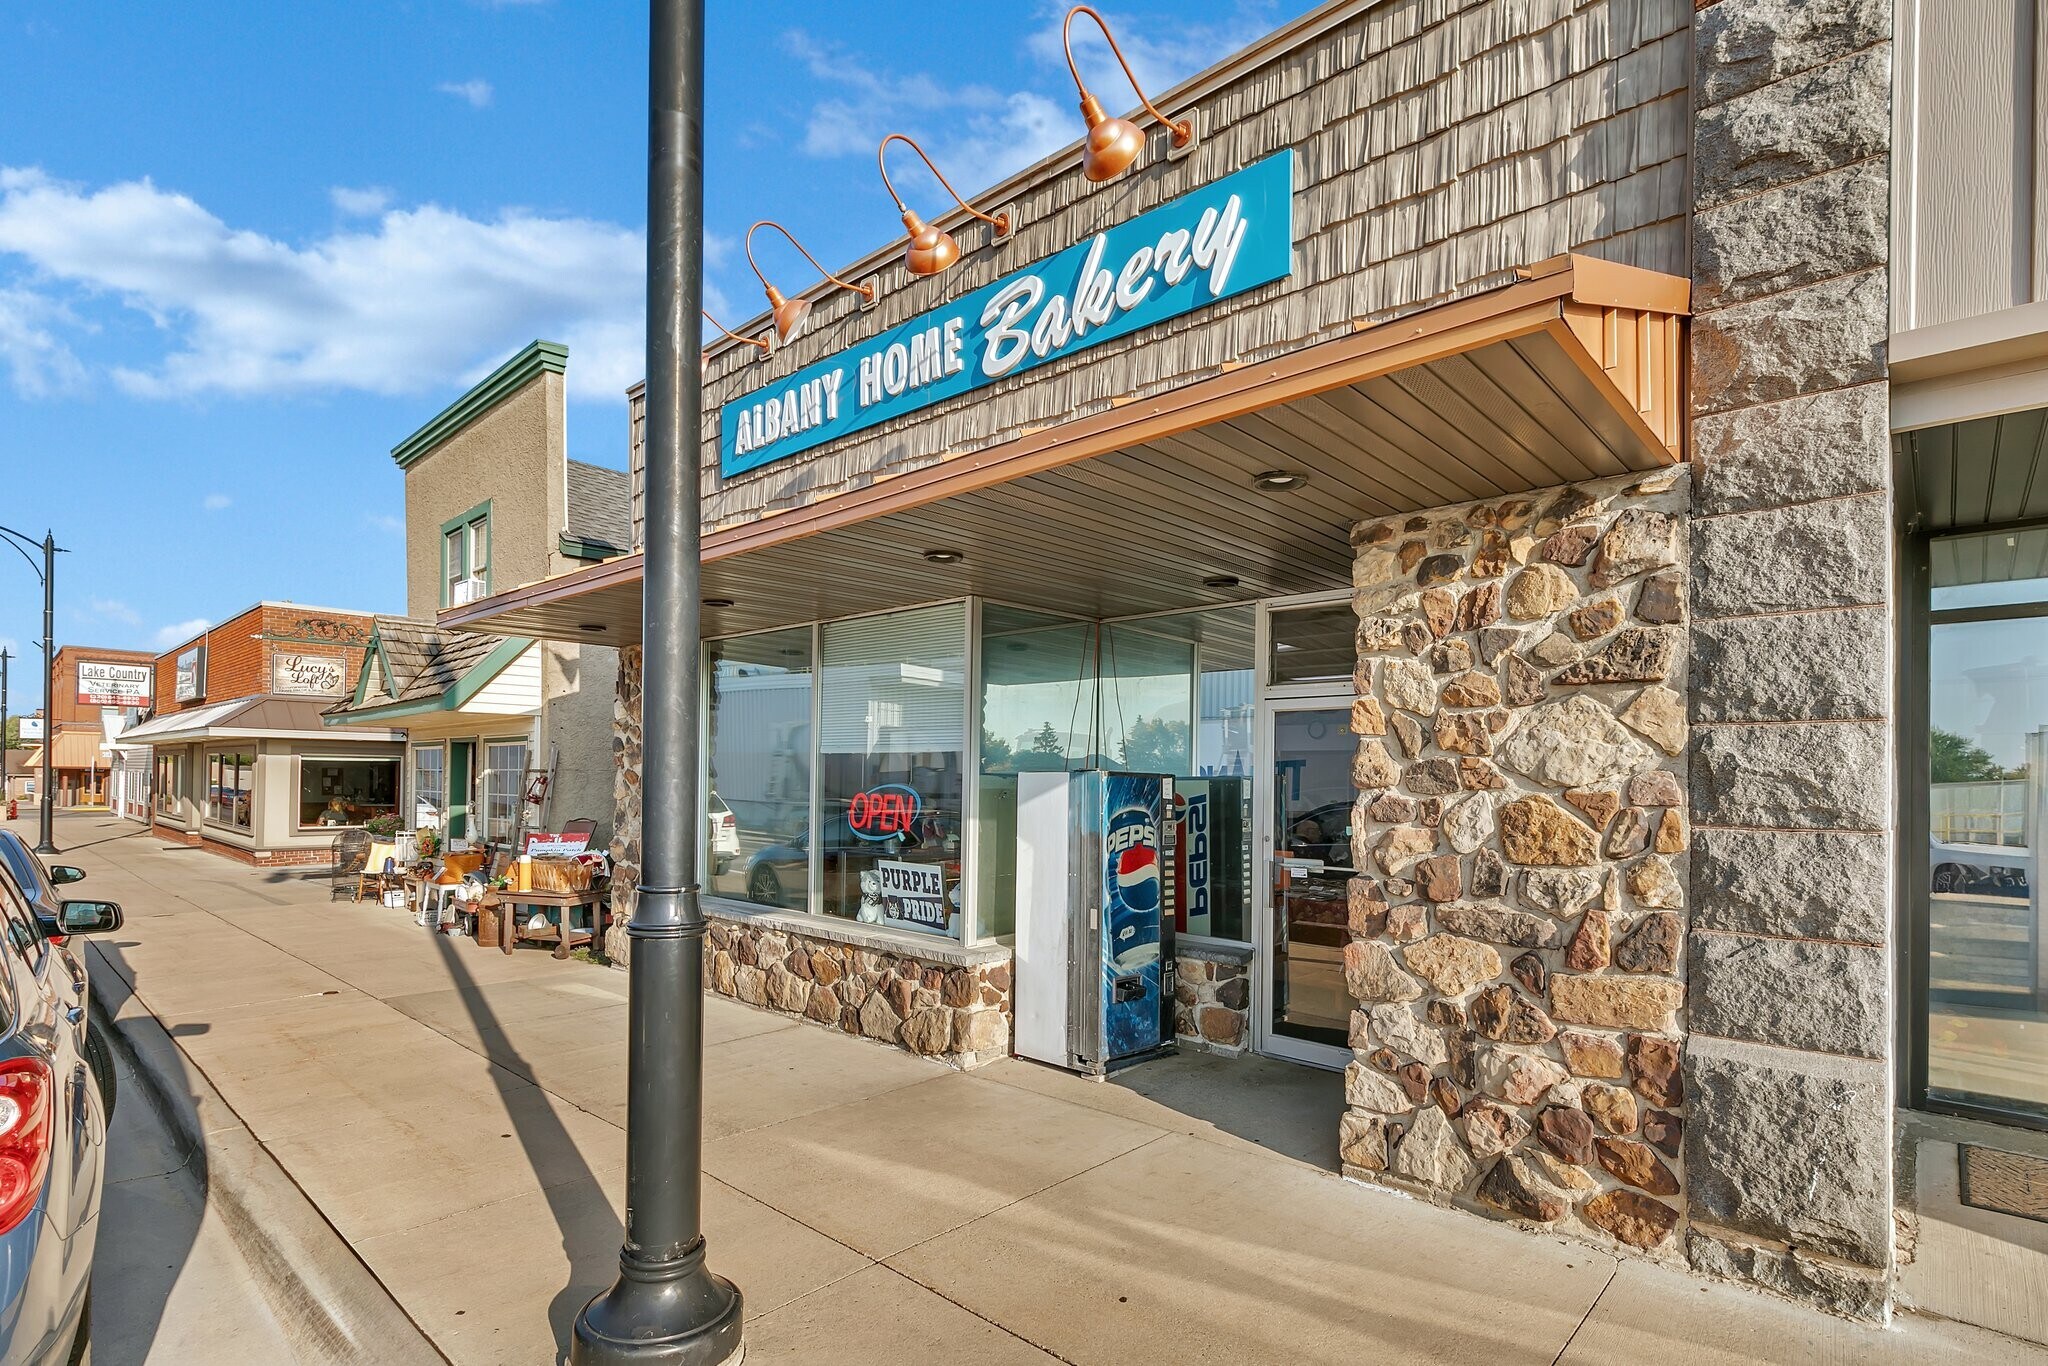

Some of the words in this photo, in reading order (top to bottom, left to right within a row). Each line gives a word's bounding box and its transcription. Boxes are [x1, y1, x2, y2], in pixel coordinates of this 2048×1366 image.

[735, 368, 844, 456] ALBANY
[859, 316, 963, 407] HOME
[980, 194, 1248, 378] Bakery
[82, 665, 105, 677] Lake
[109, 666, 148, 682] Country
[285, 655, 335, 680] Lucy's
[291, 672, 320, 688] Loft
[849, 792, 913, 832] OPEN
[880, 867, 941, 895] PURPLE
[903, 898, 944, 924] PRIDE
